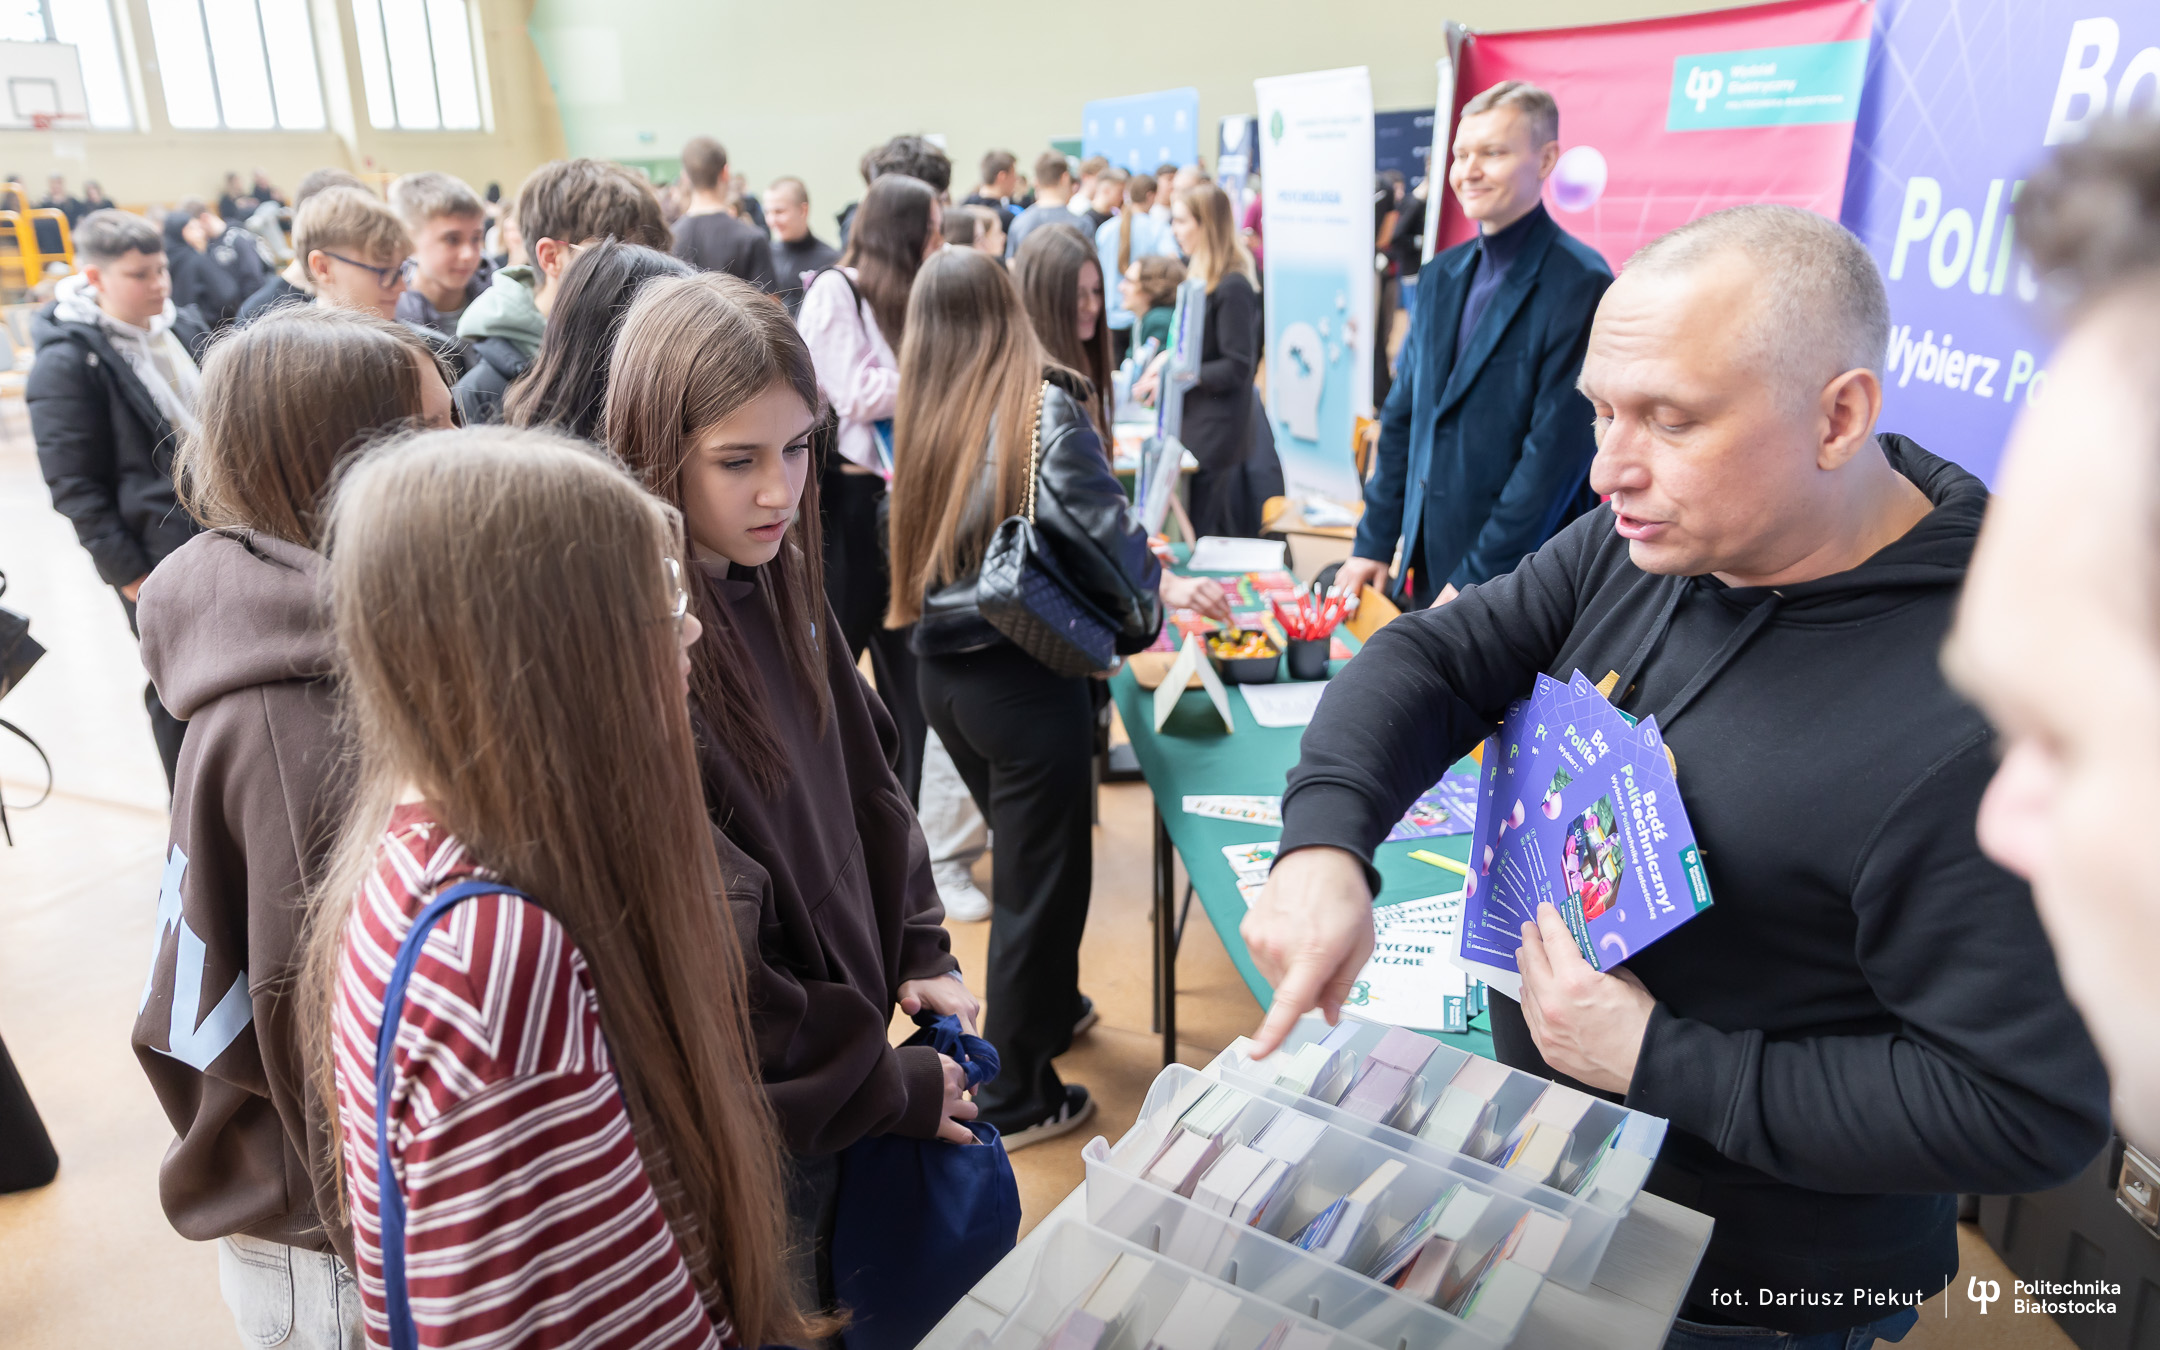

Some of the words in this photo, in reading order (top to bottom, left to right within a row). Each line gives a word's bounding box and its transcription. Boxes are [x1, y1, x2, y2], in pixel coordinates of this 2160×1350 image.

[1590, 729, 1610, 758] Bą
[1610, 773, 1626, 811] Wybierz
[1634, 865, 1657, 921] Białostocką
[1620, 763, 1676, 914] Politechniczny!
[1642, 790, 1669, 843] Bądź
